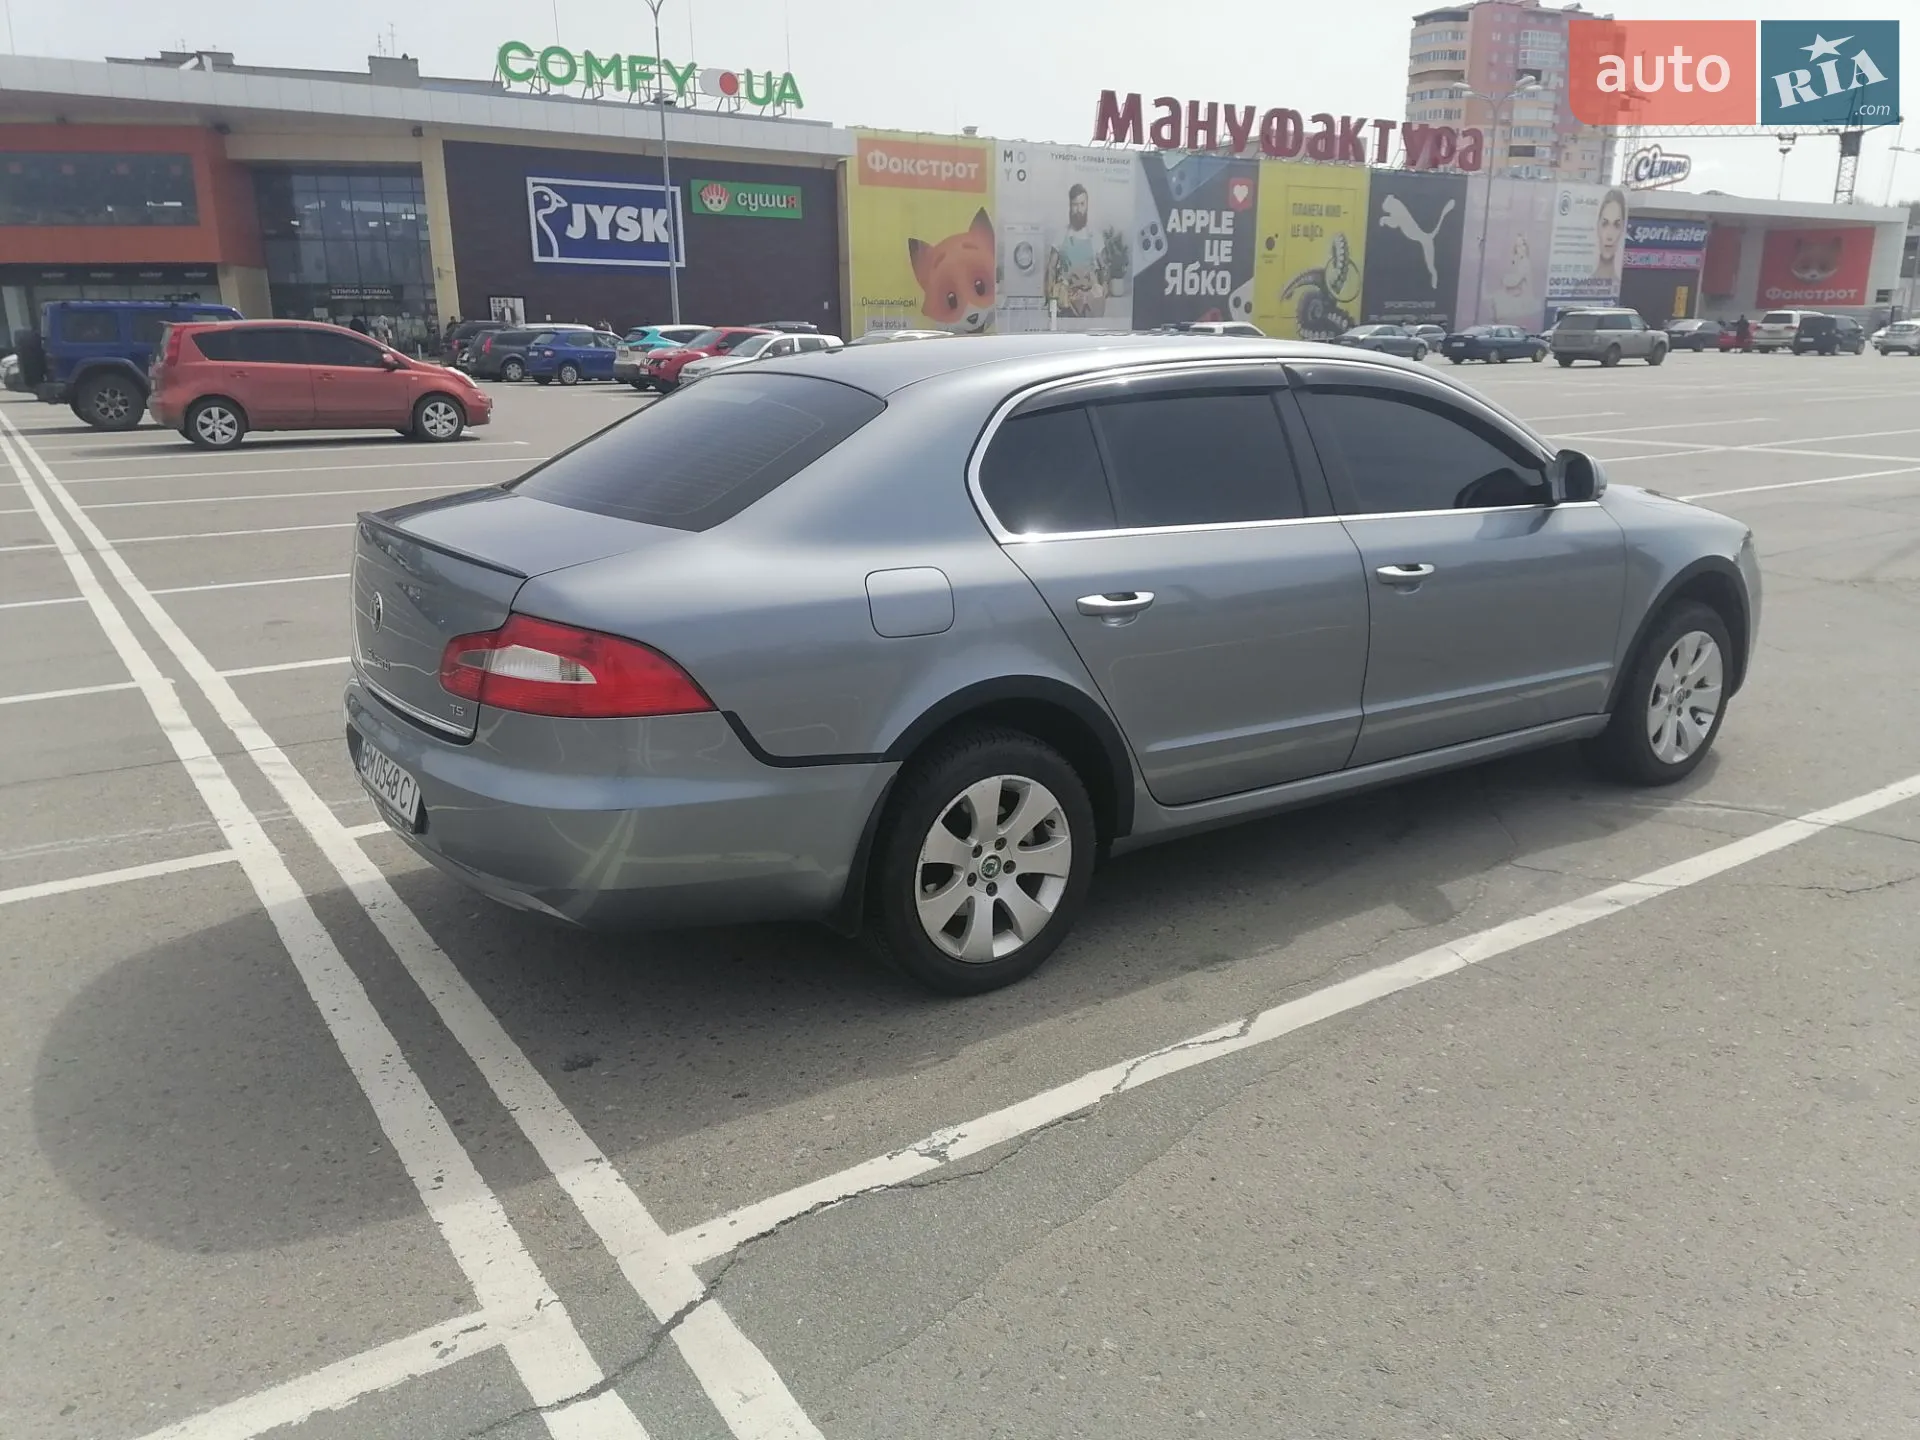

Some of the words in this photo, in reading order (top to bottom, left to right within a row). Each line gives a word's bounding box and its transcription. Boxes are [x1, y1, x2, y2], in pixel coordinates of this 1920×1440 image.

[498, 41, 697, 97] COMFY
[745, 68, 804, 109] UA
[866, 149, 979, 181] Фокстрот
[565, 204, 670, 243] JYSK
[1166, 208, 1235, 235] APPLE
[1765, 287, 1859, 302] Фокстрот
[872, 319, 907, 329] foxrot.a
